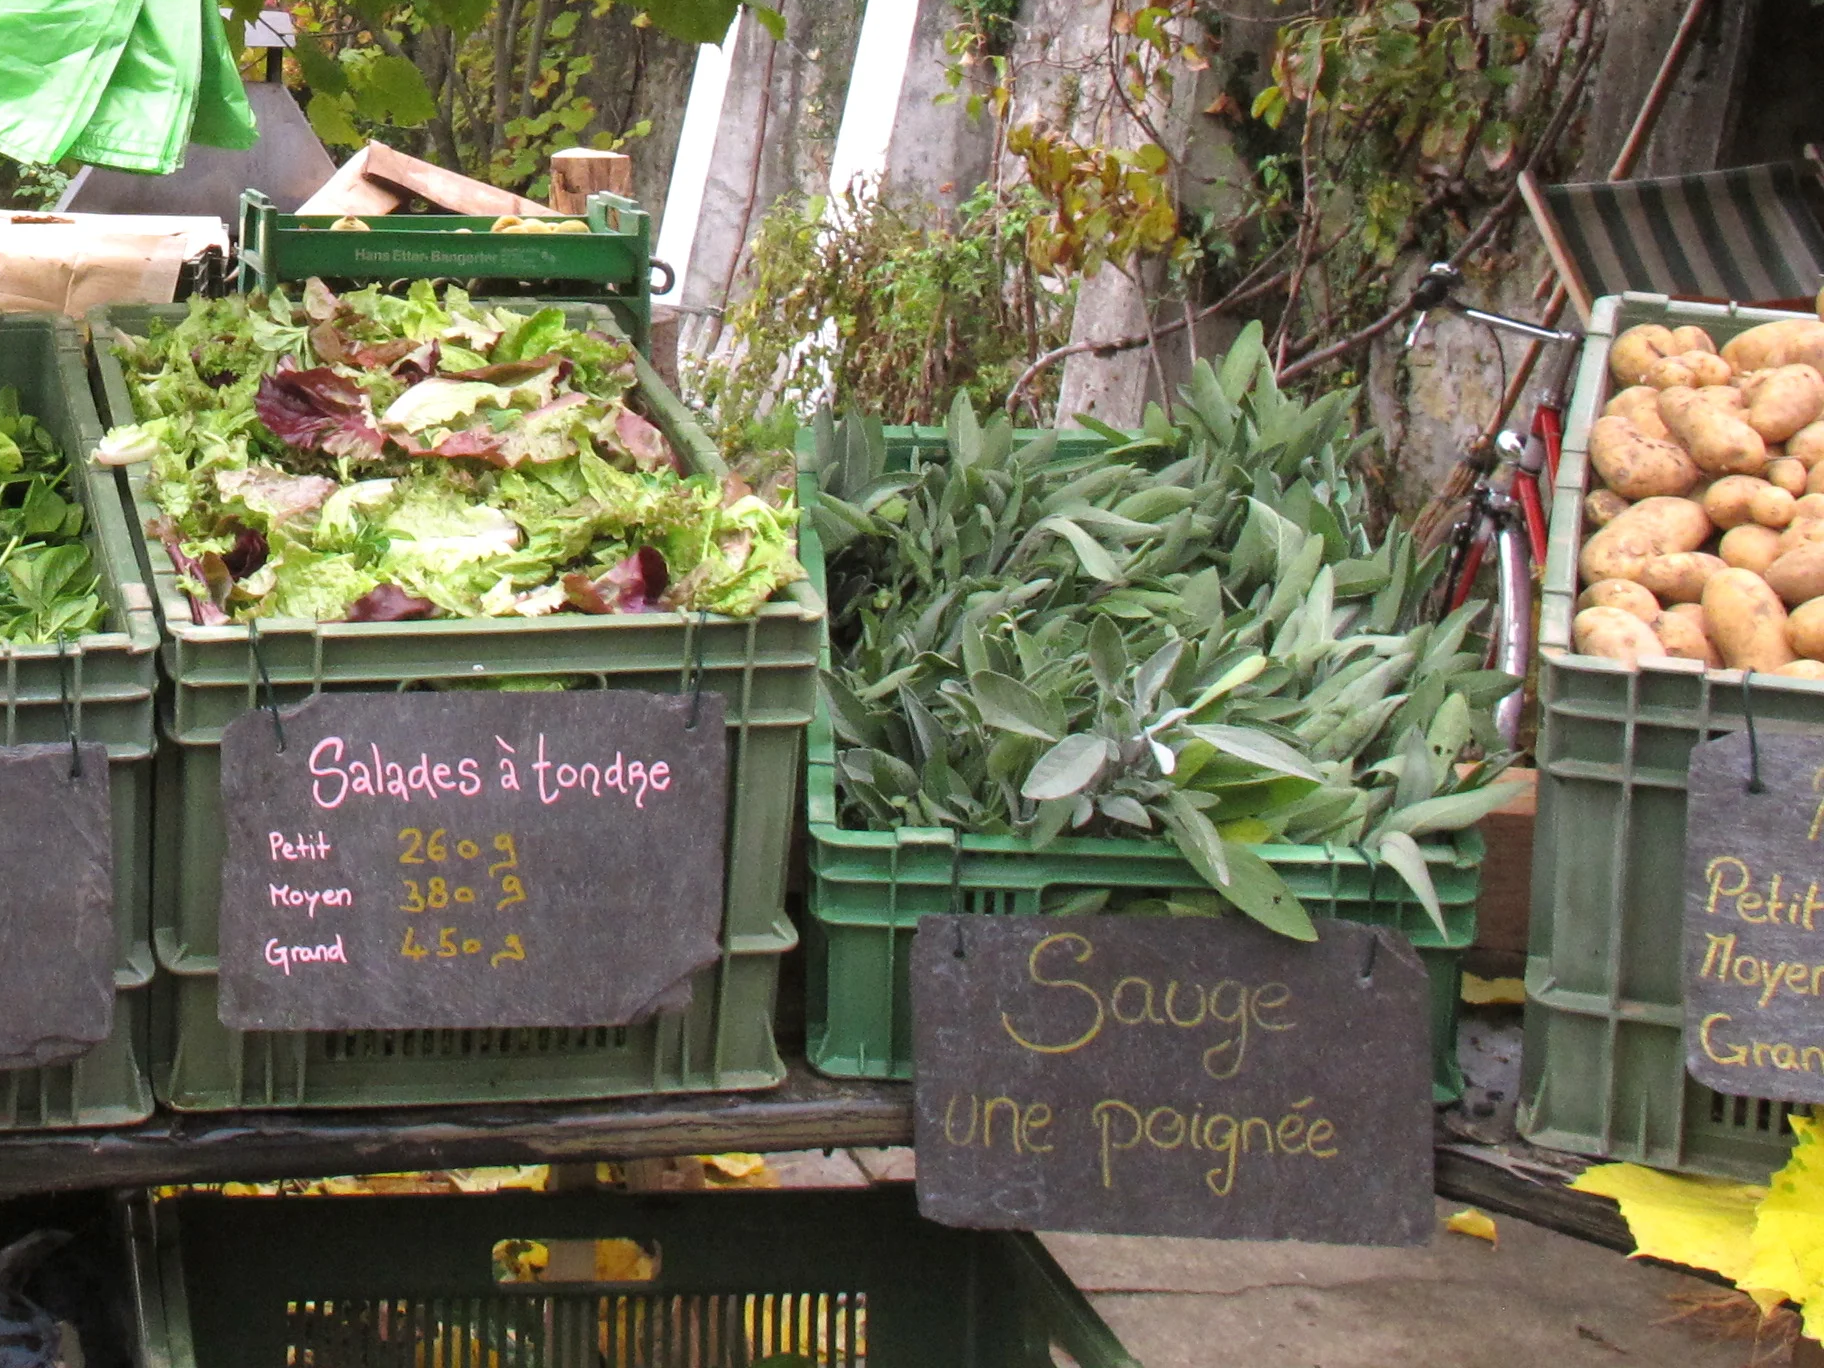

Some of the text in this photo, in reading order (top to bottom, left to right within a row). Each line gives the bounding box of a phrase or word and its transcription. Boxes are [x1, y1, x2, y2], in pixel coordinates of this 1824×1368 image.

[309, 737, 481, 809] Salades
[496, 735, 520, 791] à
[269, 830, 331, 861] Petit
[398, 828, 480, 864] 260
[269, 883, 352, 918] Moyen
[398, 878, 475, 913] 380
[1707, 856, 1824, 931] Petit
[264, 934, 348, 975] Grand
[401, 928, 481, 960] 450
[1002, 933, 1296, 1078] Sauge
[1700, 1012, 1824, 1072] Gran
[945, 1096, 1339, 1197] une poignée
